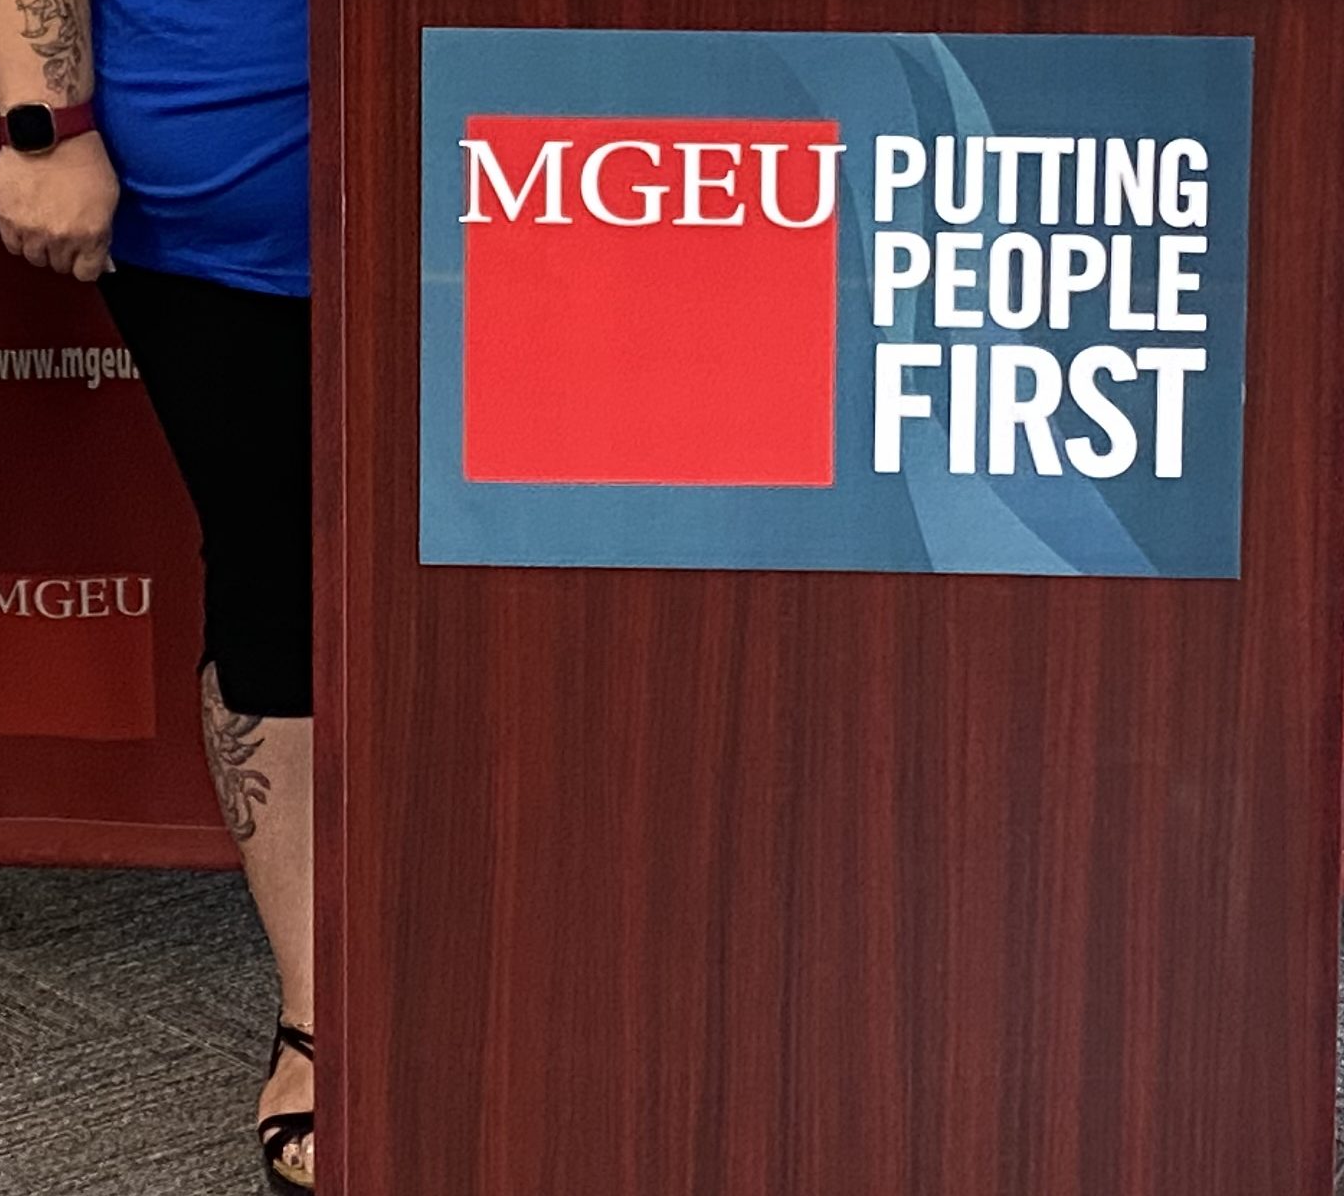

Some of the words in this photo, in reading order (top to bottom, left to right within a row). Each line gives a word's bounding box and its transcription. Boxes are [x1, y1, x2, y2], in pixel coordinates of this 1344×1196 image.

[458, 139, 847, 228] MGEU
[873, 135, 1209, 229] PUTTING
[872, 233, 1208, 332] PEOPLE
[873, 342, 1208, 479] FIRST
